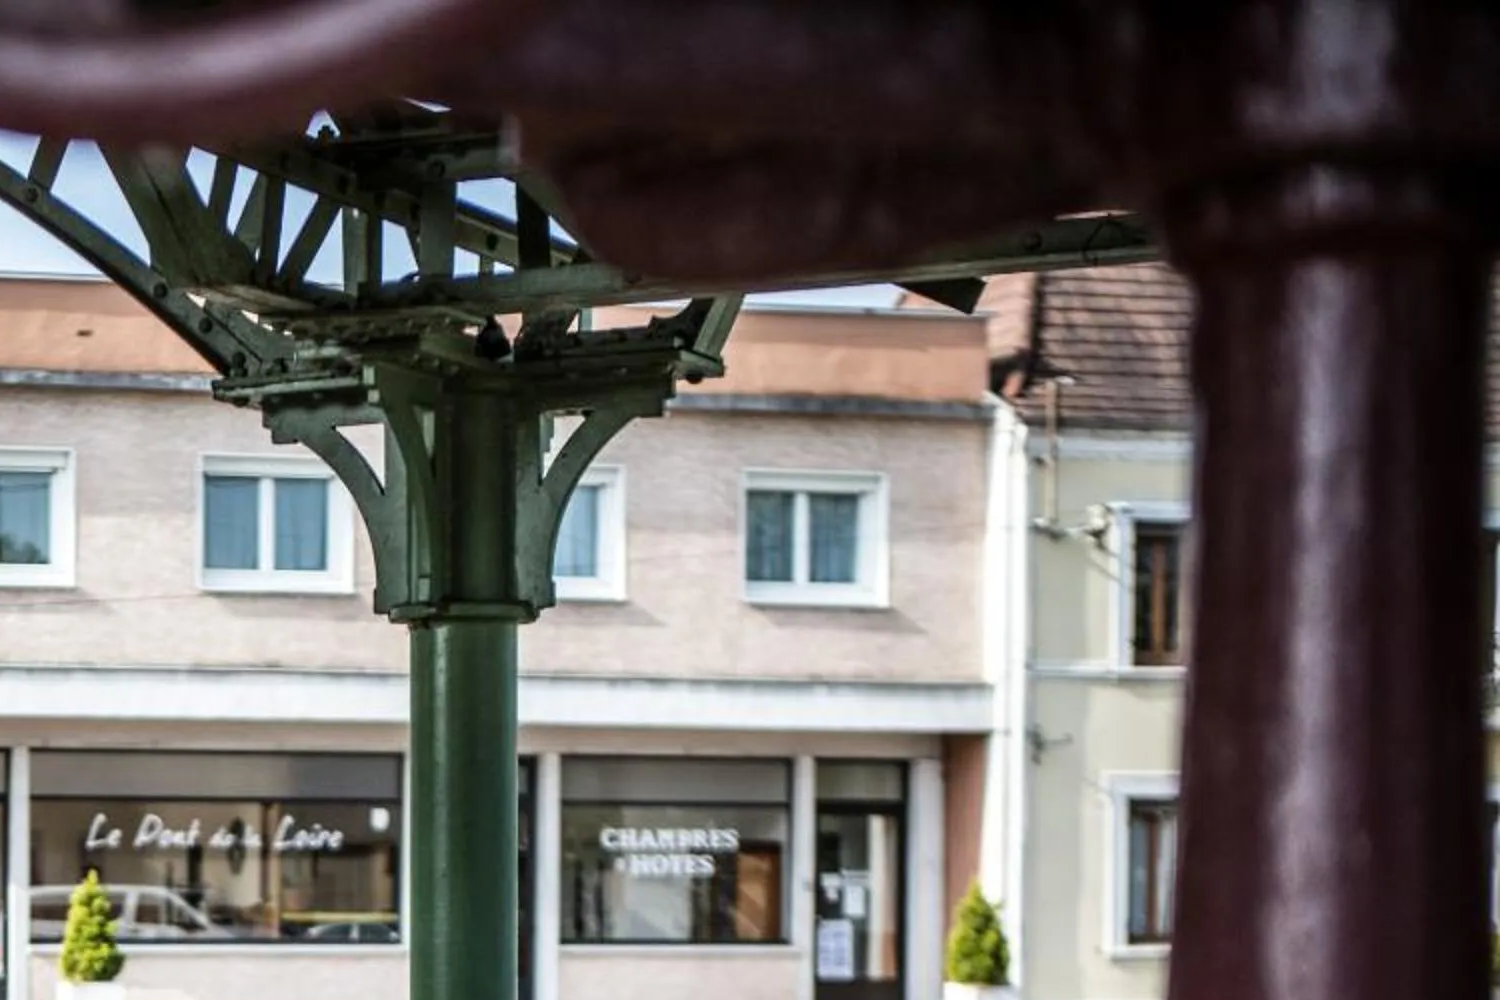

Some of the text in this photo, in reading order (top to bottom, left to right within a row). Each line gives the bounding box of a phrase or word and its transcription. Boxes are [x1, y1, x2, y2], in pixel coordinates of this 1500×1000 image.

[85, 812, 122, 850] Le
[273, 814, 344, 851] Loire
[599, 827, 740, 851] CHAMBRES
